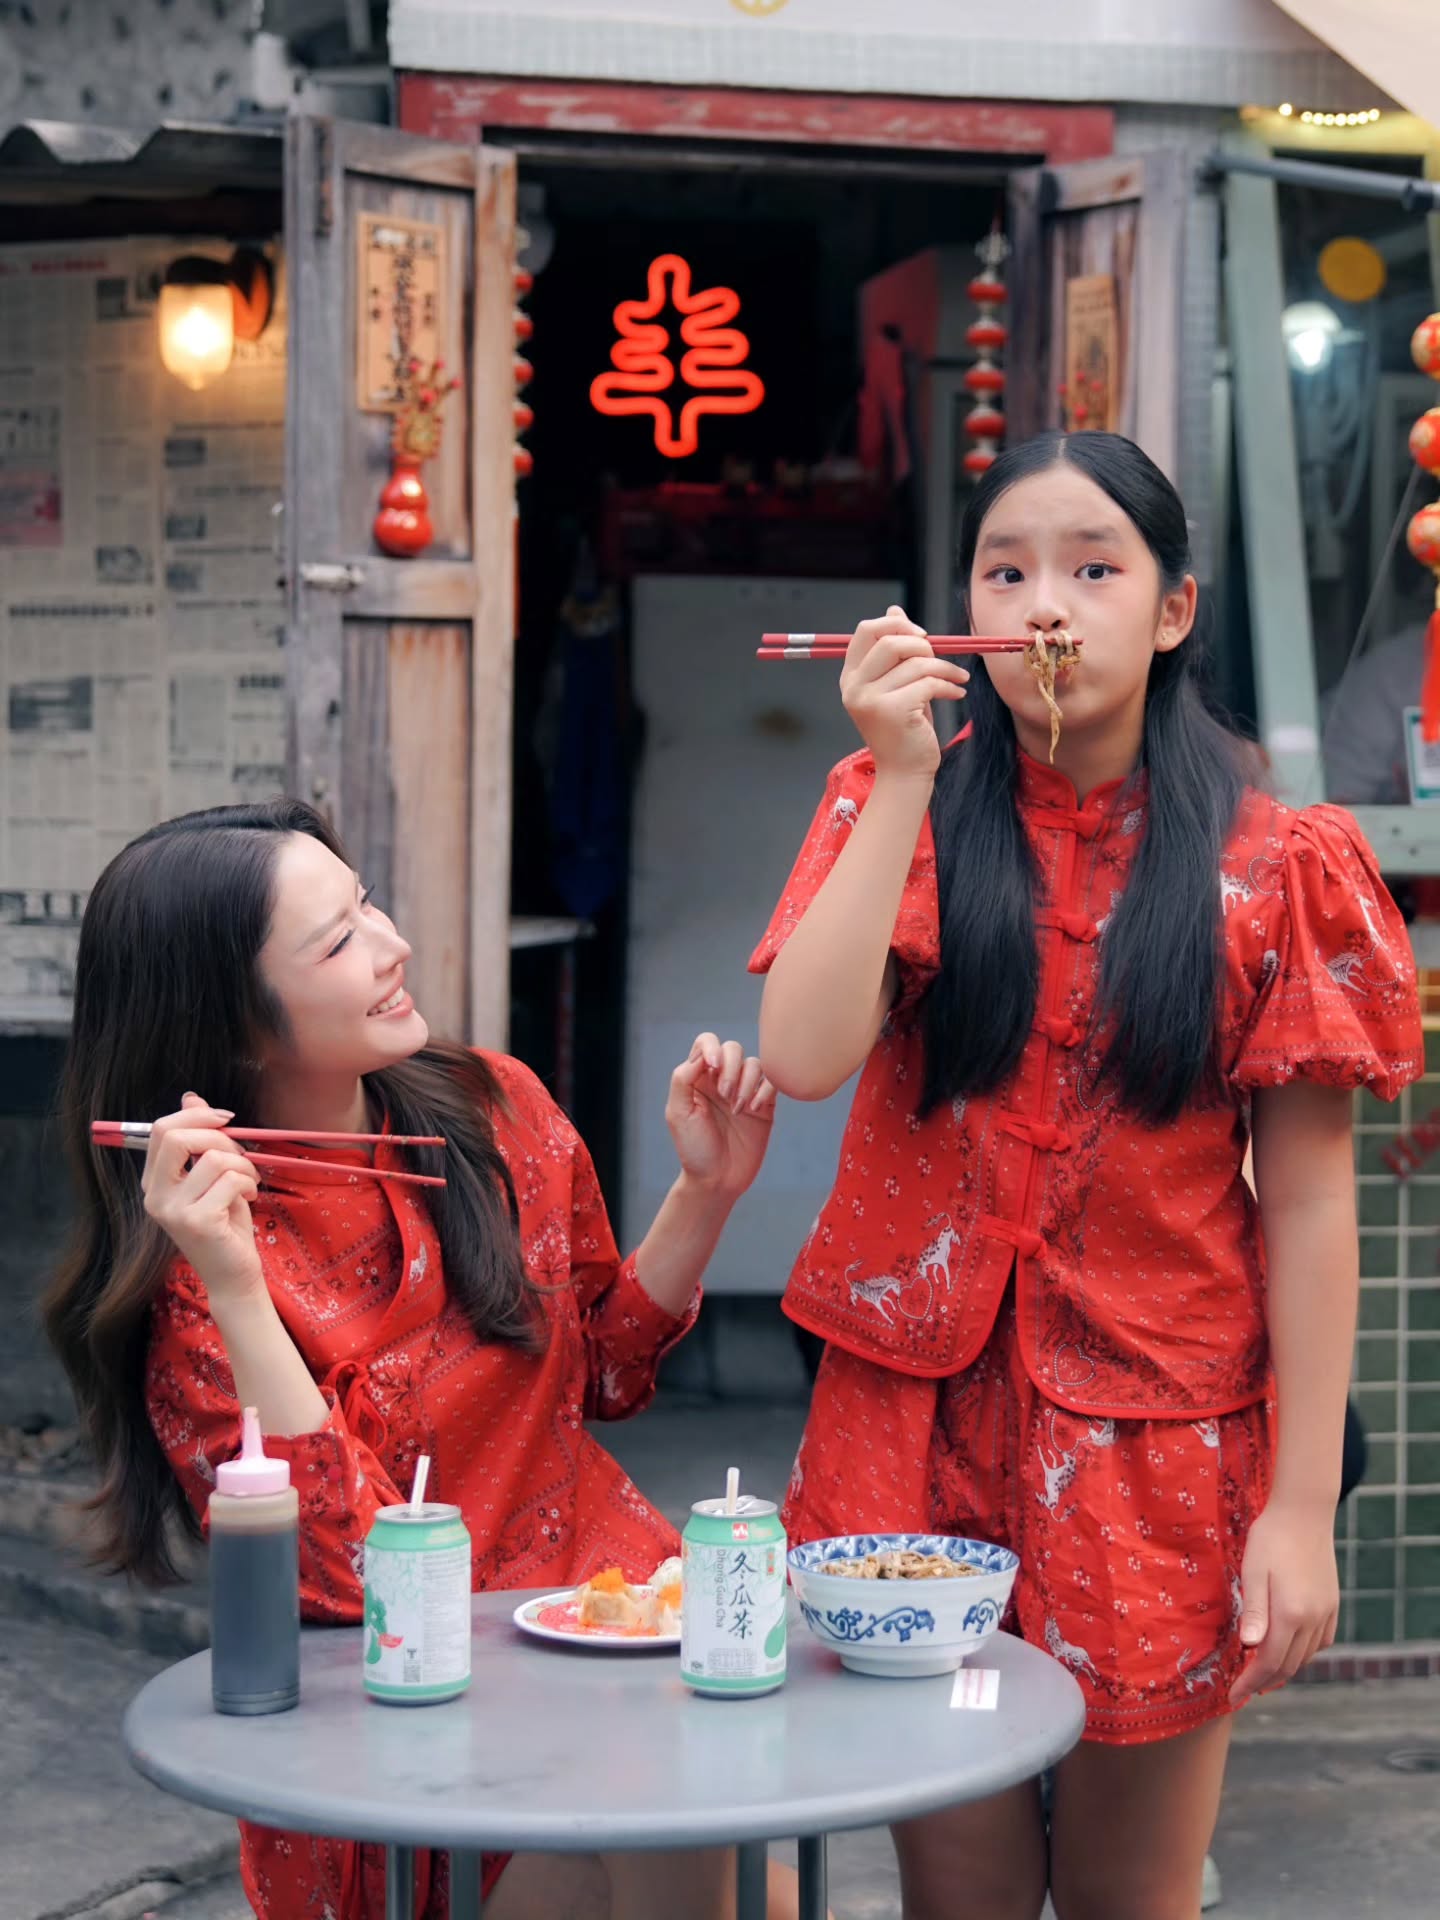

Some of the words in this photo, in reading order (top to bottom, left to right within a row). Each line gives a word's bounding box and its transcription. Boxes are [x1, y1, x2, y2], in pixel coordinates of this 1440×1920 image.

[716, 1608, 726, 1628] Cha
[729, 1552, 757, 1639] 冬瓜茶
